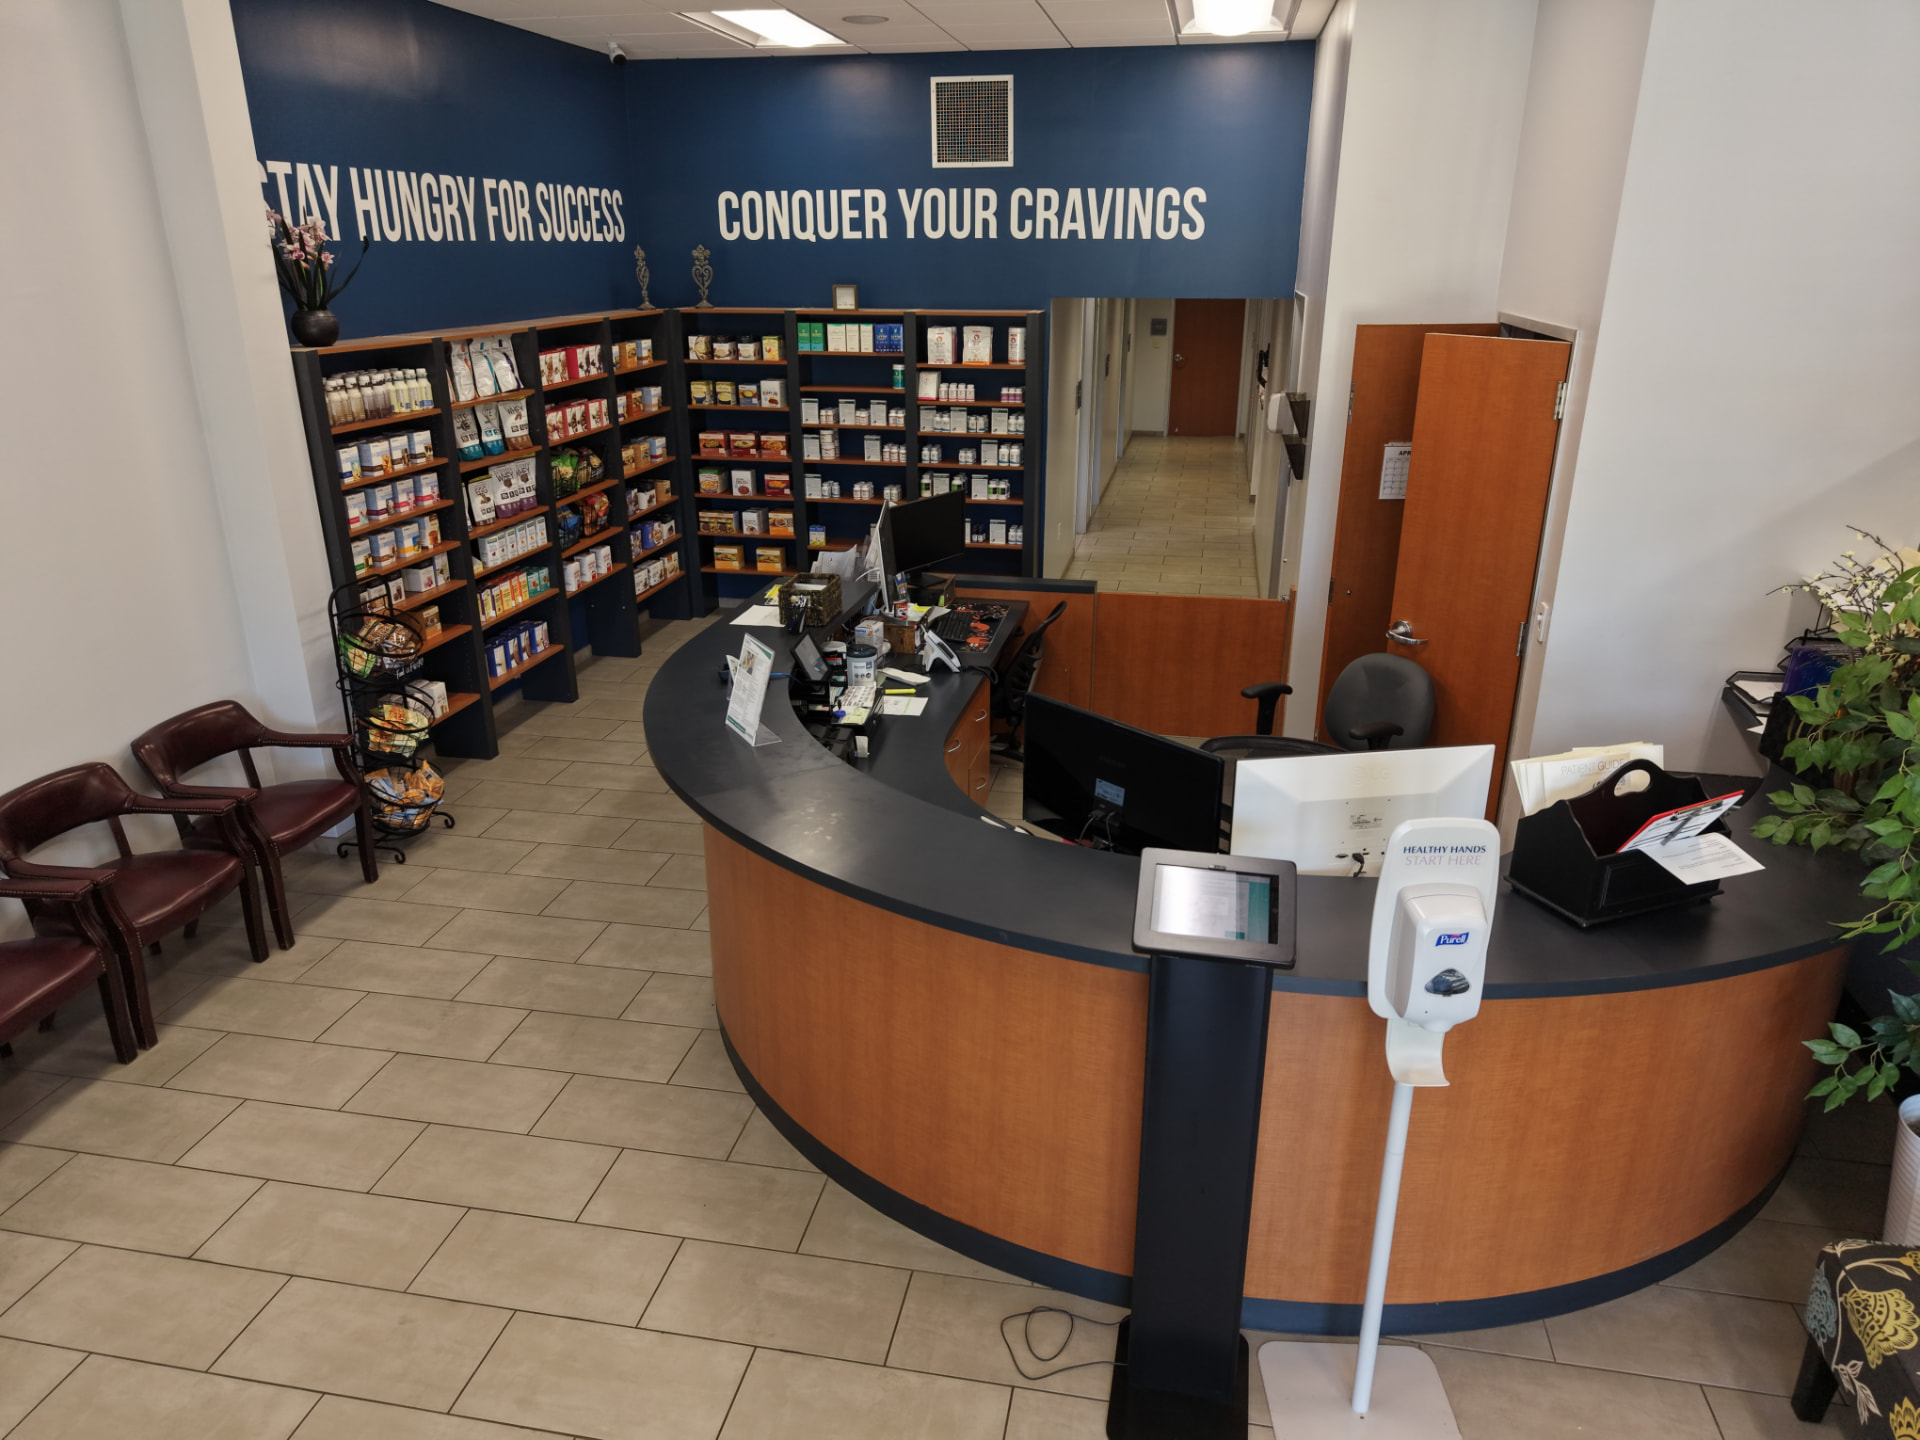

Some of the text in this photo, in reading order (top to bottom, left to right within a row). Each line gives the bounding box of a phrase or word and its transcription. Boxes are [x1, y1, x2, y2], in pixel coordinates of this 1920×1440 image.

[349, 167, 477, 242] HUNGRY
[482, 178, 534, 242] FOR
[536, 182, 625, 243] SUCCESS
[717, 186, 1208, 243] CONQUER YOUR CRAVINGS
[1561, 758, 1625, 776] PATIENT GUIDE
[1403, 845, 1486, 854] HEALTHY HANDS
[1405, 855, 1481, 866] START HERE
[1440, 934, 1467, 944] Purell
